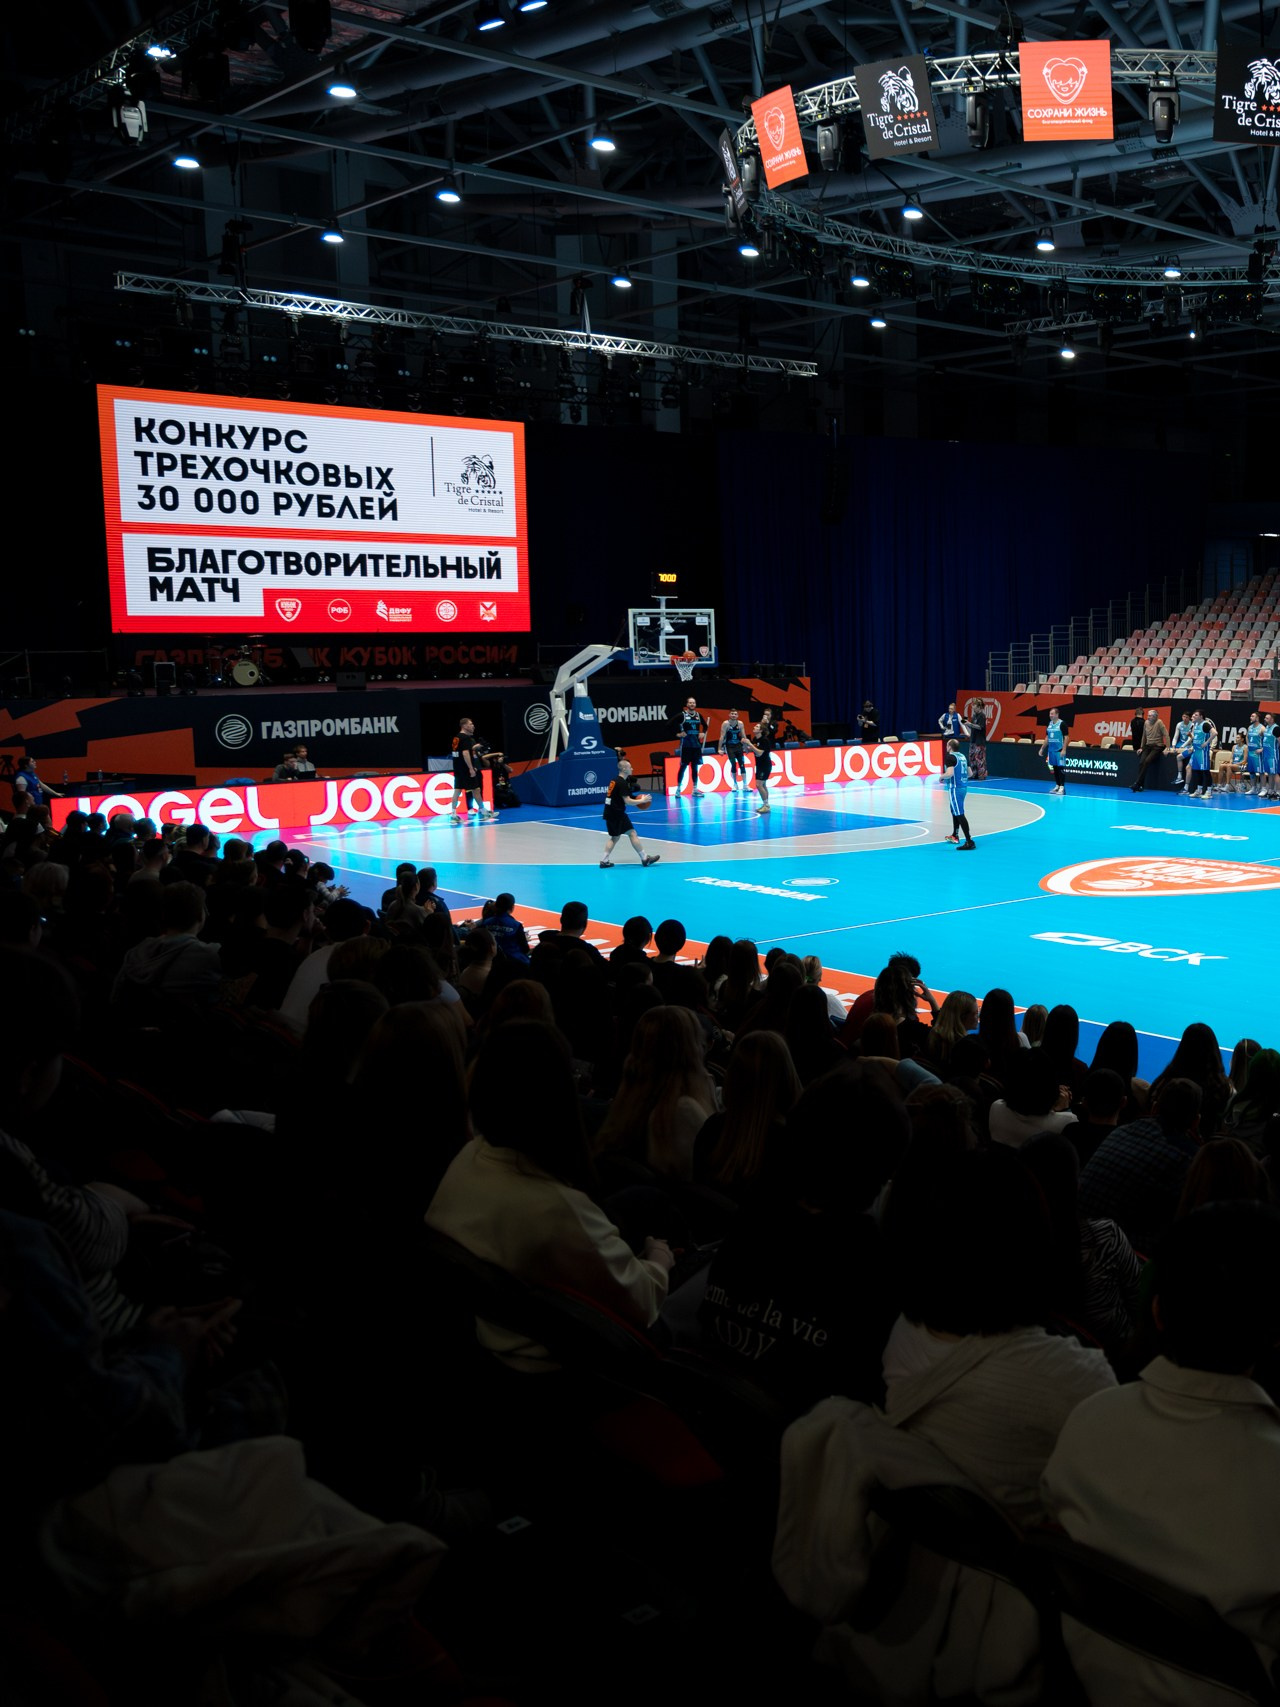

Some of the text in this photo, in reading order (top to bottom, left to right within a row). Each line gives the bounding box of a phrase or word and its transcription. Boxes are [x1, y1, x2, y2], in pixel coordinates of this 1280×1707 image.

[1027, 107, 1108, 119] СОХРАНИ ЖИЗНЬ
[1222, 95, 1257, 114] Tigre
[867, 113, 894, 129] Tigre
[883, 118, 931, 140] de Cristal
[1238, 113, 1252, 126] de
[914, 135, 932, 143] Resort
[766, 153, 785, 169] СОХРАНИ
[134, 417, 308, 454] КОНКУРС
[134, 451, 395, 491] ТРЕХОЧКОВЫХ
[444, 482, 472, 496] Tigre
[137, 485, 399, 521] 30 000 РУБЛЕЙ
[458, 495, 504, 507] de Cristal
[146, 546, 502, 580] БЛАГОТВОРИТЕЛЬНЫЙ
[149, 576, 241, 603] МАТЧ
[331, 606, 349, 614] РФБ
[135, 645, 518, 669] ГАЗПБК КУБОК РОССИИ
[564, 705, 669, 724] РОМБАНК
[261, 716, 400, 740] ГАЗПРОМБАНК
[1095, 720, 1133, 738] ФИНА
[824, 742, 942, 784] JOGEL
[1065, 758, 1118, 771] ХРАНИ ЖИЗНЬ
[310, 773, 490, 825] JOGE
[568, 786, 609, 796] ГАЗПРОМБАН
[1099, 936, 1229, 966] ВСК
[793, 1316, 828, 1347] vie
